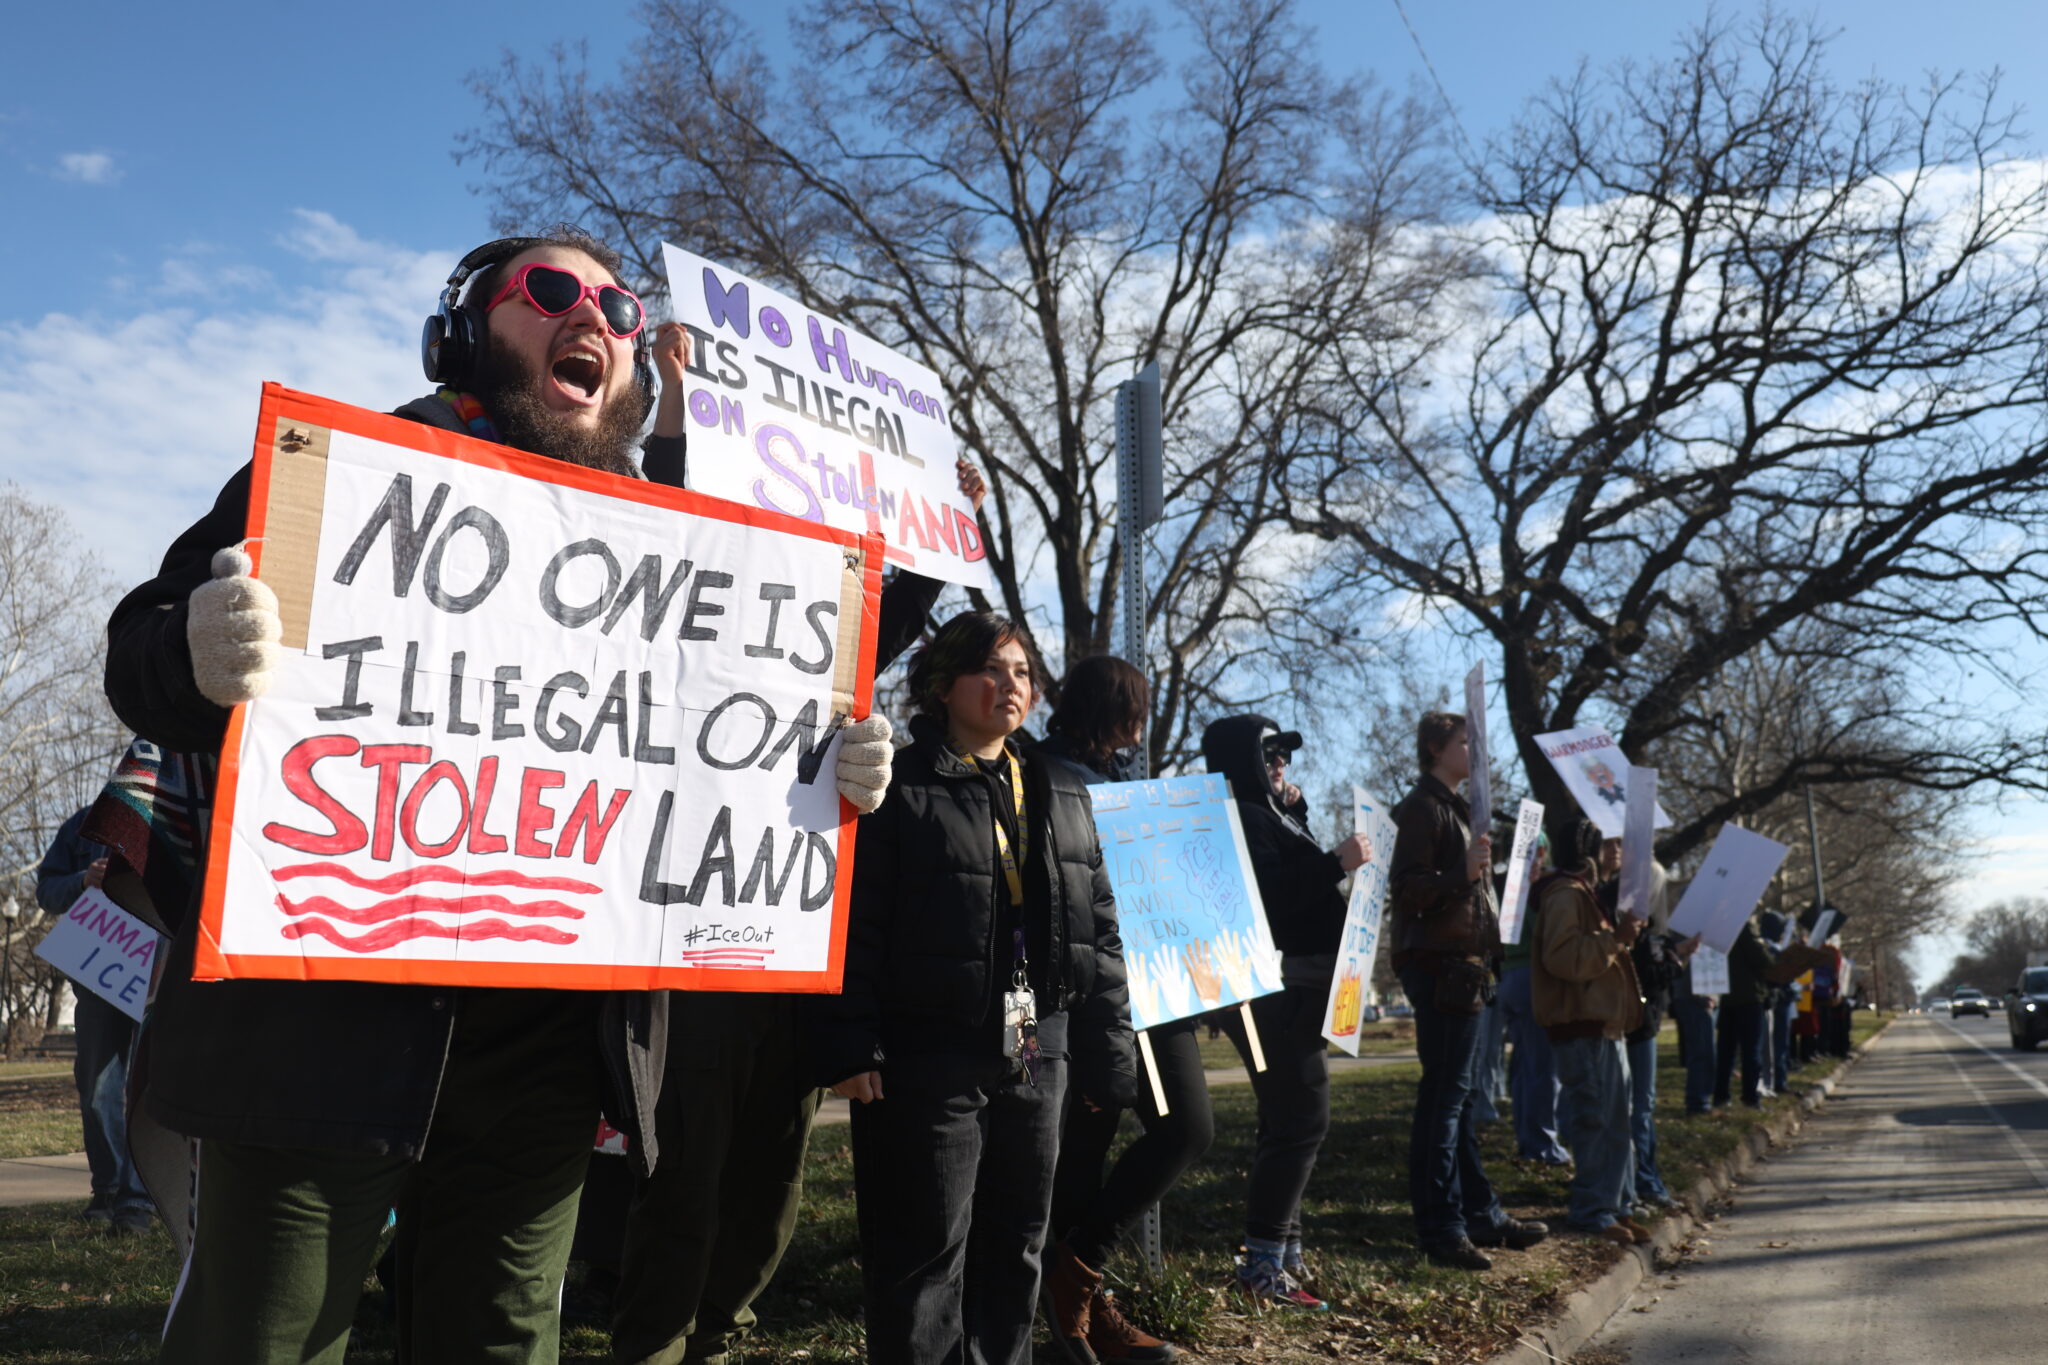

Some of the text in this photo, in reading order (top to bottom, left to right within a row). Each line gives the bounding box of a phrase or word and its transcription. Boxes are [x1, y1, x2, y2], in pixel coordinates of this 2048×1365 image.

[681, 322, 926, 469] IS ILLEGAL
[688, 388, 746, 437] ON
[333, 472, 838, 675] NO ONE IS
[315, 636, 848, 787] ILLEGAL ON
[262, 734, 838, 913] STOLEN LAND
[1114, 842, 1175, 889] LOVE
[683, 923, 775, 948] #IceOut
[1124, 916, 1190, 948] WINS
[79, 946, 147, 1005] ICE
